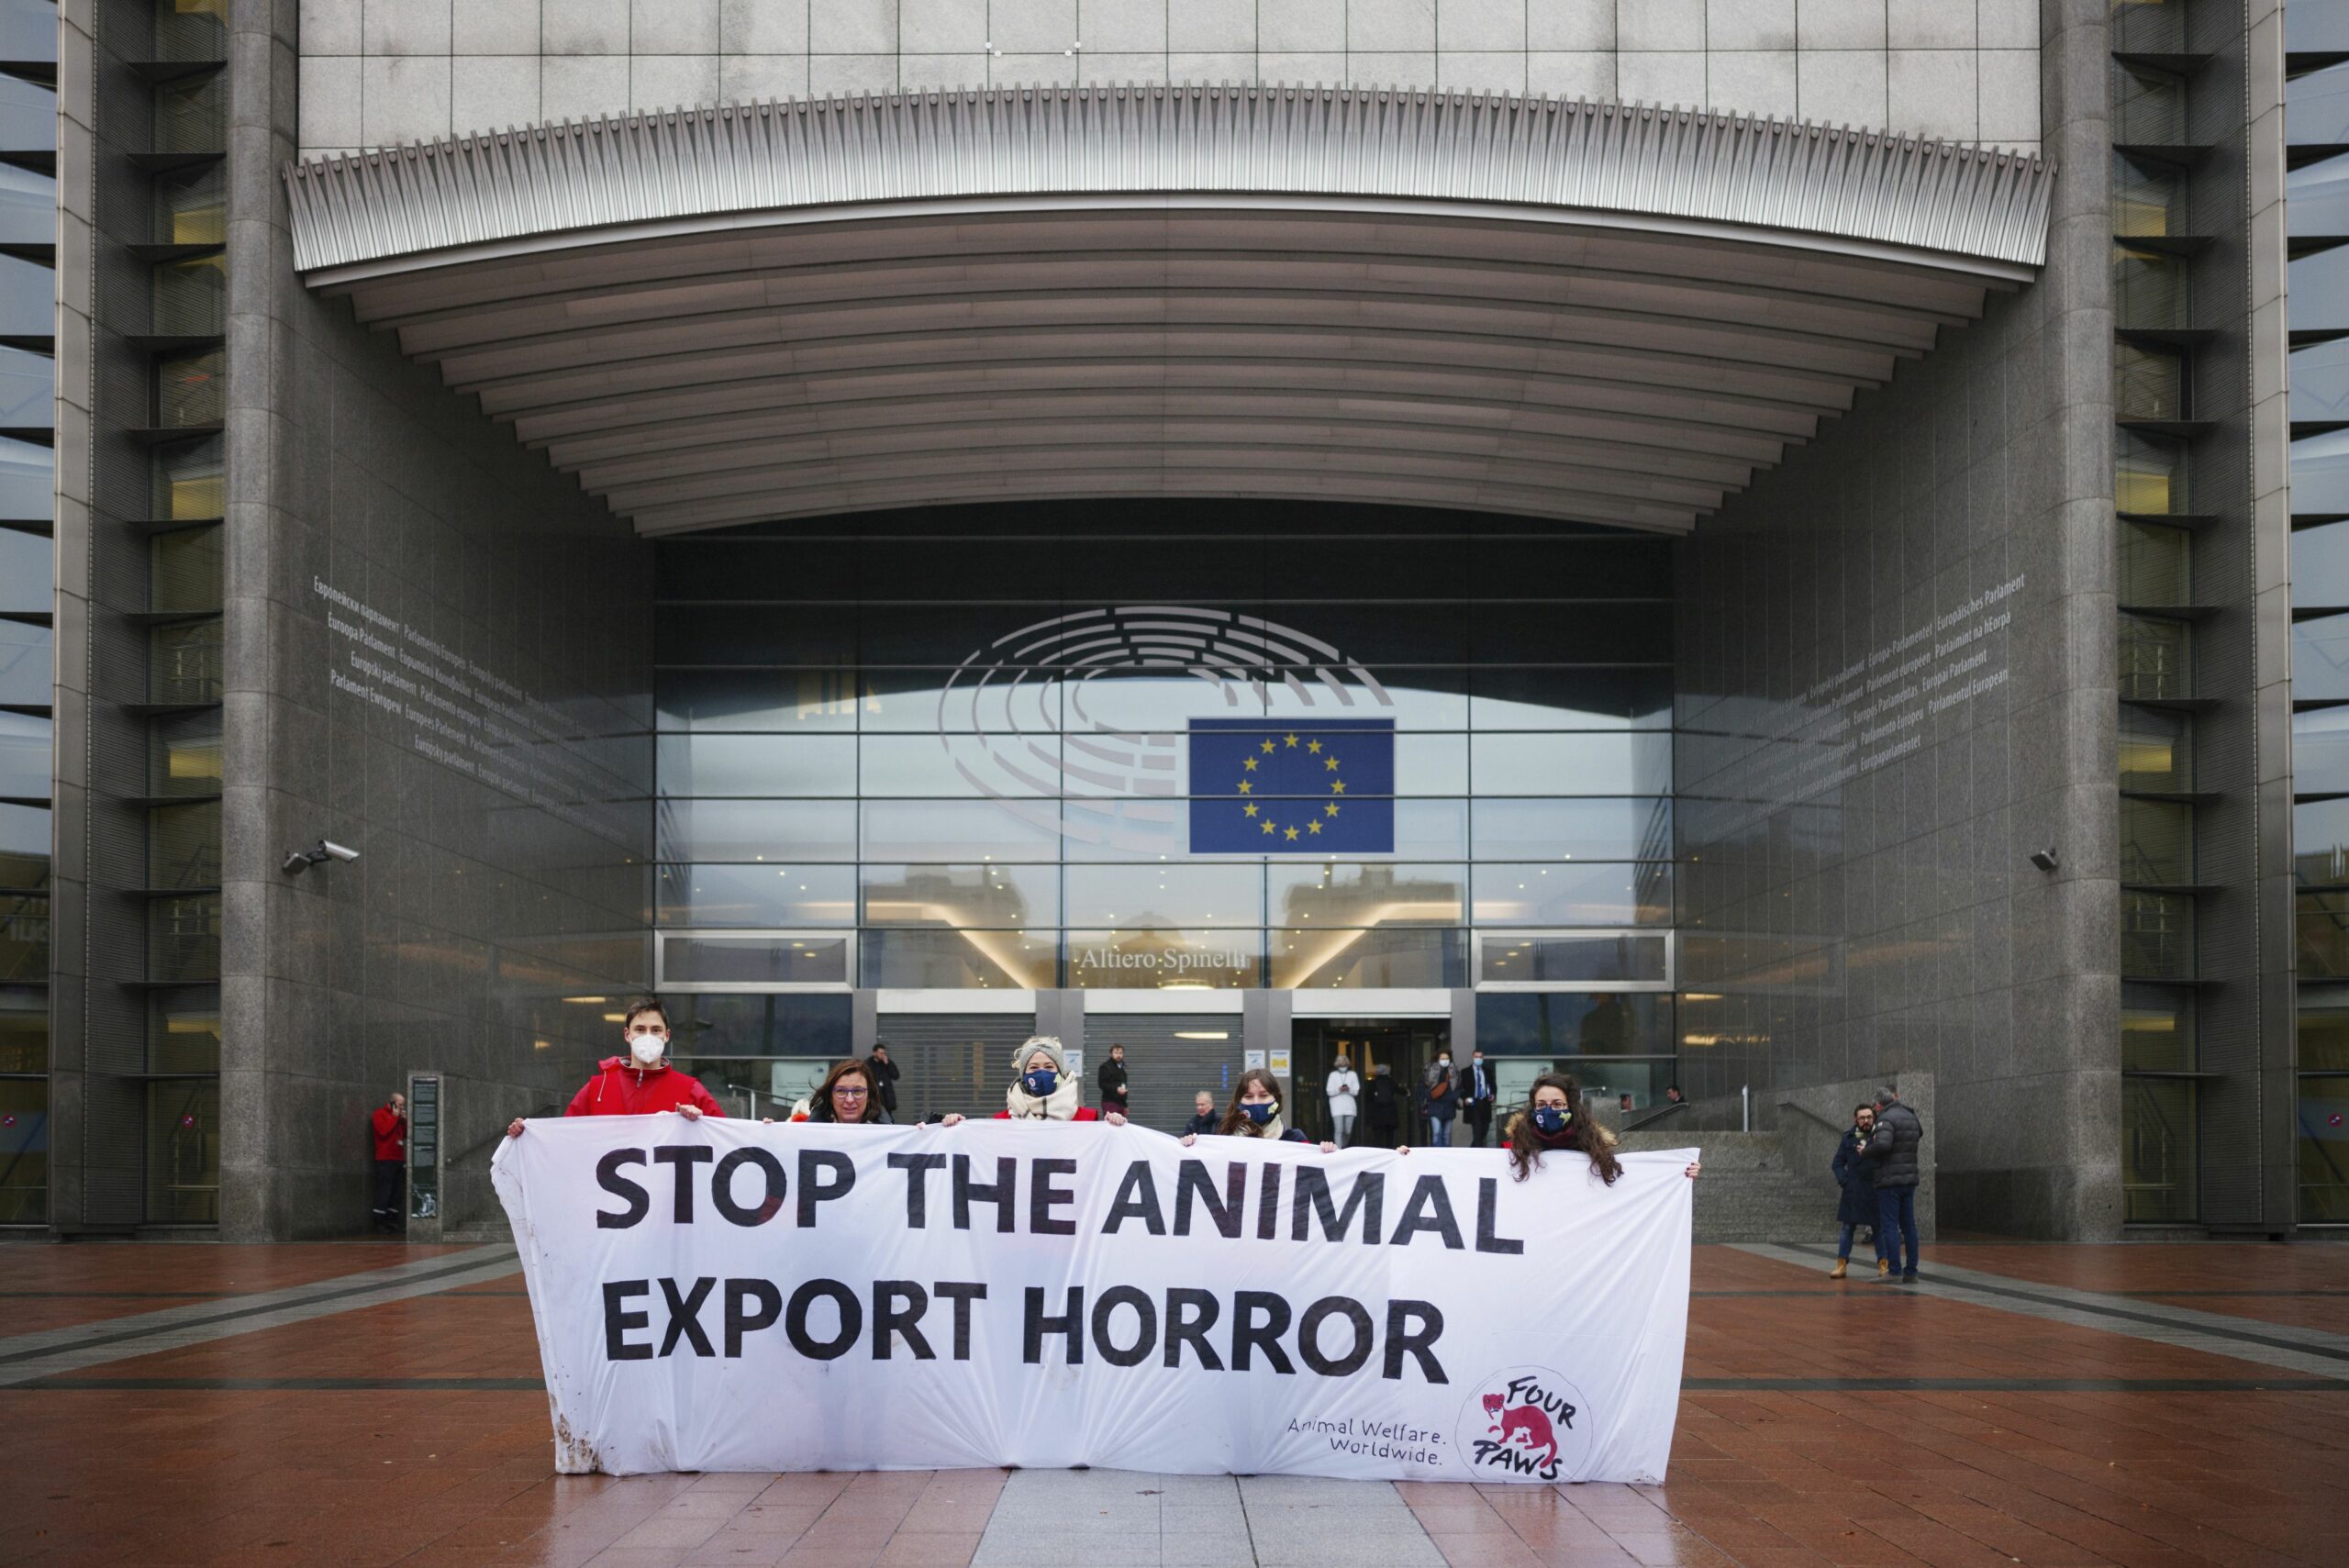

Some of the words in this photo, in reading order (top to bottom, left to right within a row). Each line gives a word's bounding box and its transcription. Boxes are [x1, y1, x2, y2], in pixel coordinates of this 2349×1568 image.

[360, 604, 399, 632] парламент
[1937, 597, 1983, 630] Europäisches
[1984, 573, 2024, 605] Parlament
[328, 611, 358, 640] Euroopa
[359, 628, 395, 658] Parlament
[404, 623, 440, 655] Parlamento
[1865, 667, 1898, 692] Parlement
[1934, 629, 1971, 658] Parlaimint
[1973, 626, 1982, 639] na
[1984, 607, 2010, 633] hEorpa
[330, 668, 369, 699] Parlament
[370, 686, 401, 714] Ewropew
[405, 703, 434, 729] Europees
[435, 717, 466, 745] Parlement
[351, 651, 381, 678] Europski
[382, 670, 417, 695] parlament
[420, 684, 456, 714] Parlamento
[1853, 705, 1877, 725] Europos
[1878, 684, 1918, 711] Parlamentas
[1949, 649, 1987, 677] Parlament
[1860, 720, 1896, 745] Parlamento
[1897, 708, 1923, 729] Europeu
[1928, 681, 1971, 714] Parlamentul
[1972, 665, 2008, 695] European
[443, 751, 474, 773] parlament
[1860, 734, 1920, 771] Europaparlamentet
[1080, 949, 1156, 969] Altiero
[1163, 948, 1246, 973] Spinelli
[596, 1145, 856, 1229] STOP
[886, 1152, 1077, 1235] THE
[1100, 1159, 1524, 1255] ANIMAL
[602, 1276, 987, 1361] EXPORT
[1023, 1284, 1449, 1385] HORROR
[1507, 1375, 1576, 1429] FOUR
[1287, 1418, 1353, 1435] Animal
[1362, 1419, 1446, 1445] Welfare.
[1330, 1438, 1442, 1466] Worldwide.
[1473, 1440, 1563, 1481] PAWS
